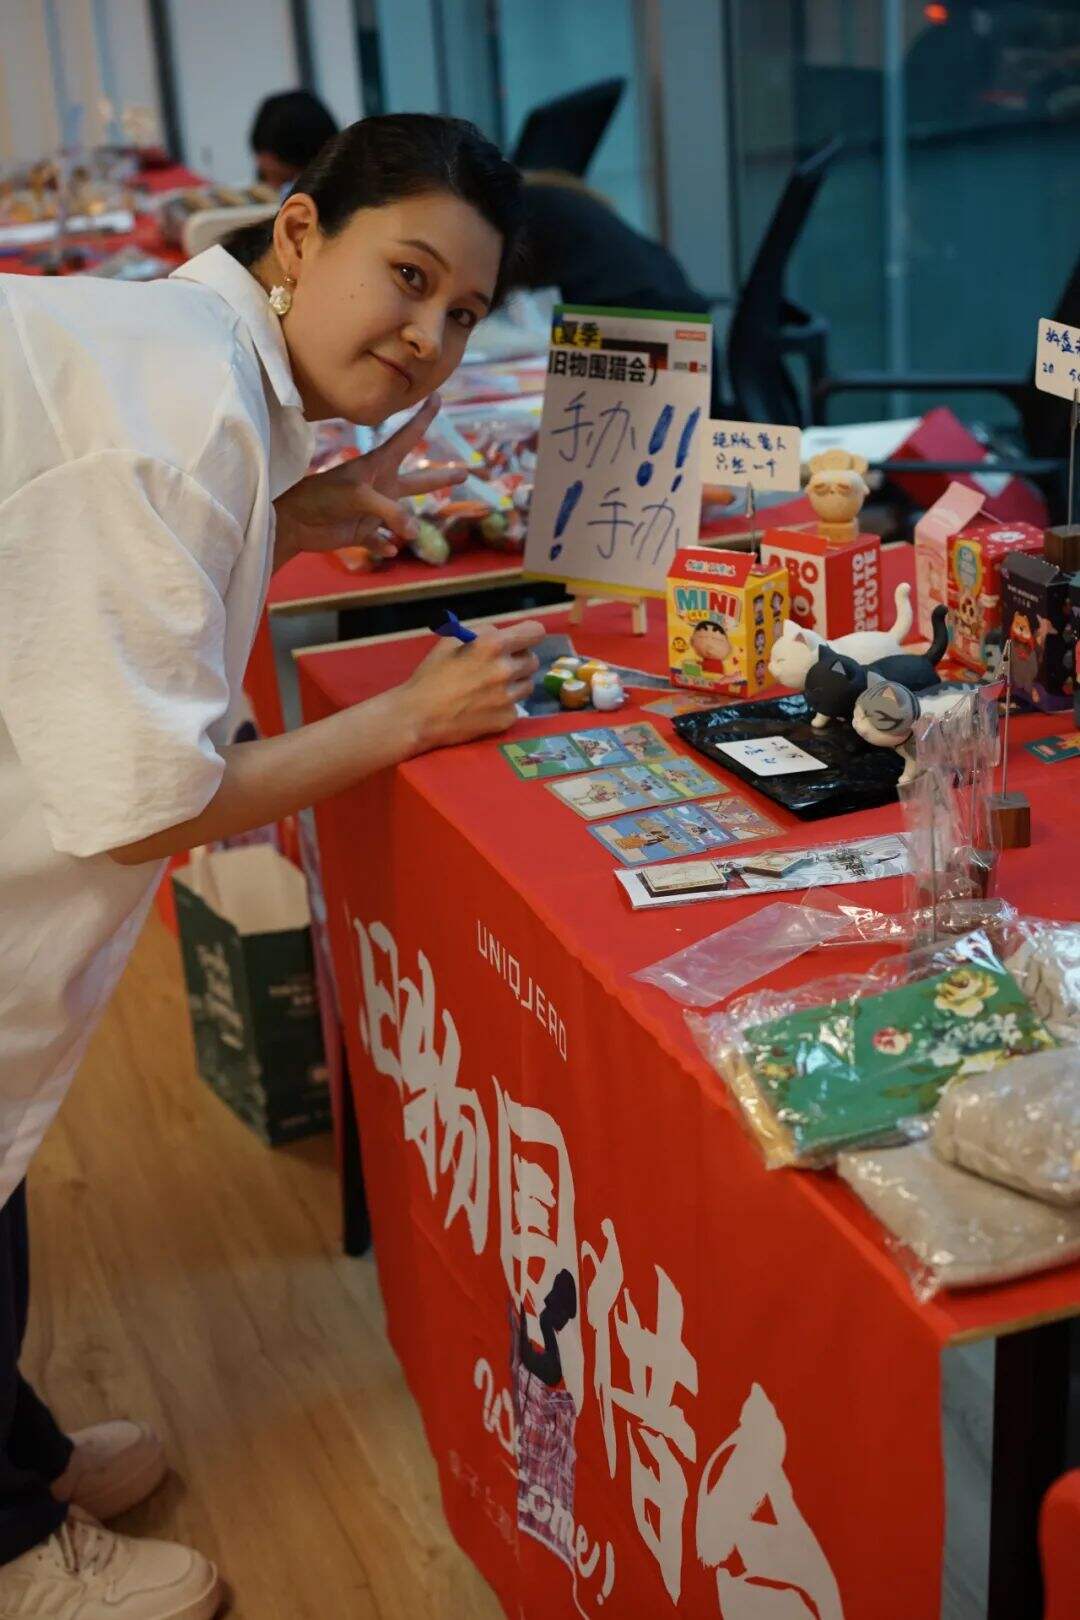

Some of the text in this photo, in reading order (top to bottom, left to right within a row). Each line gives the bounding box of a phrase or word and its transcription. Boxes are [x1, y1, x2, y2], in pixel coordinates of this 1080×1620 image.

[549, 350, 647, 384] 旧物围猎会
[863, 549, 878, 612] CUTE
[675, 587, 738, 619] MINI
